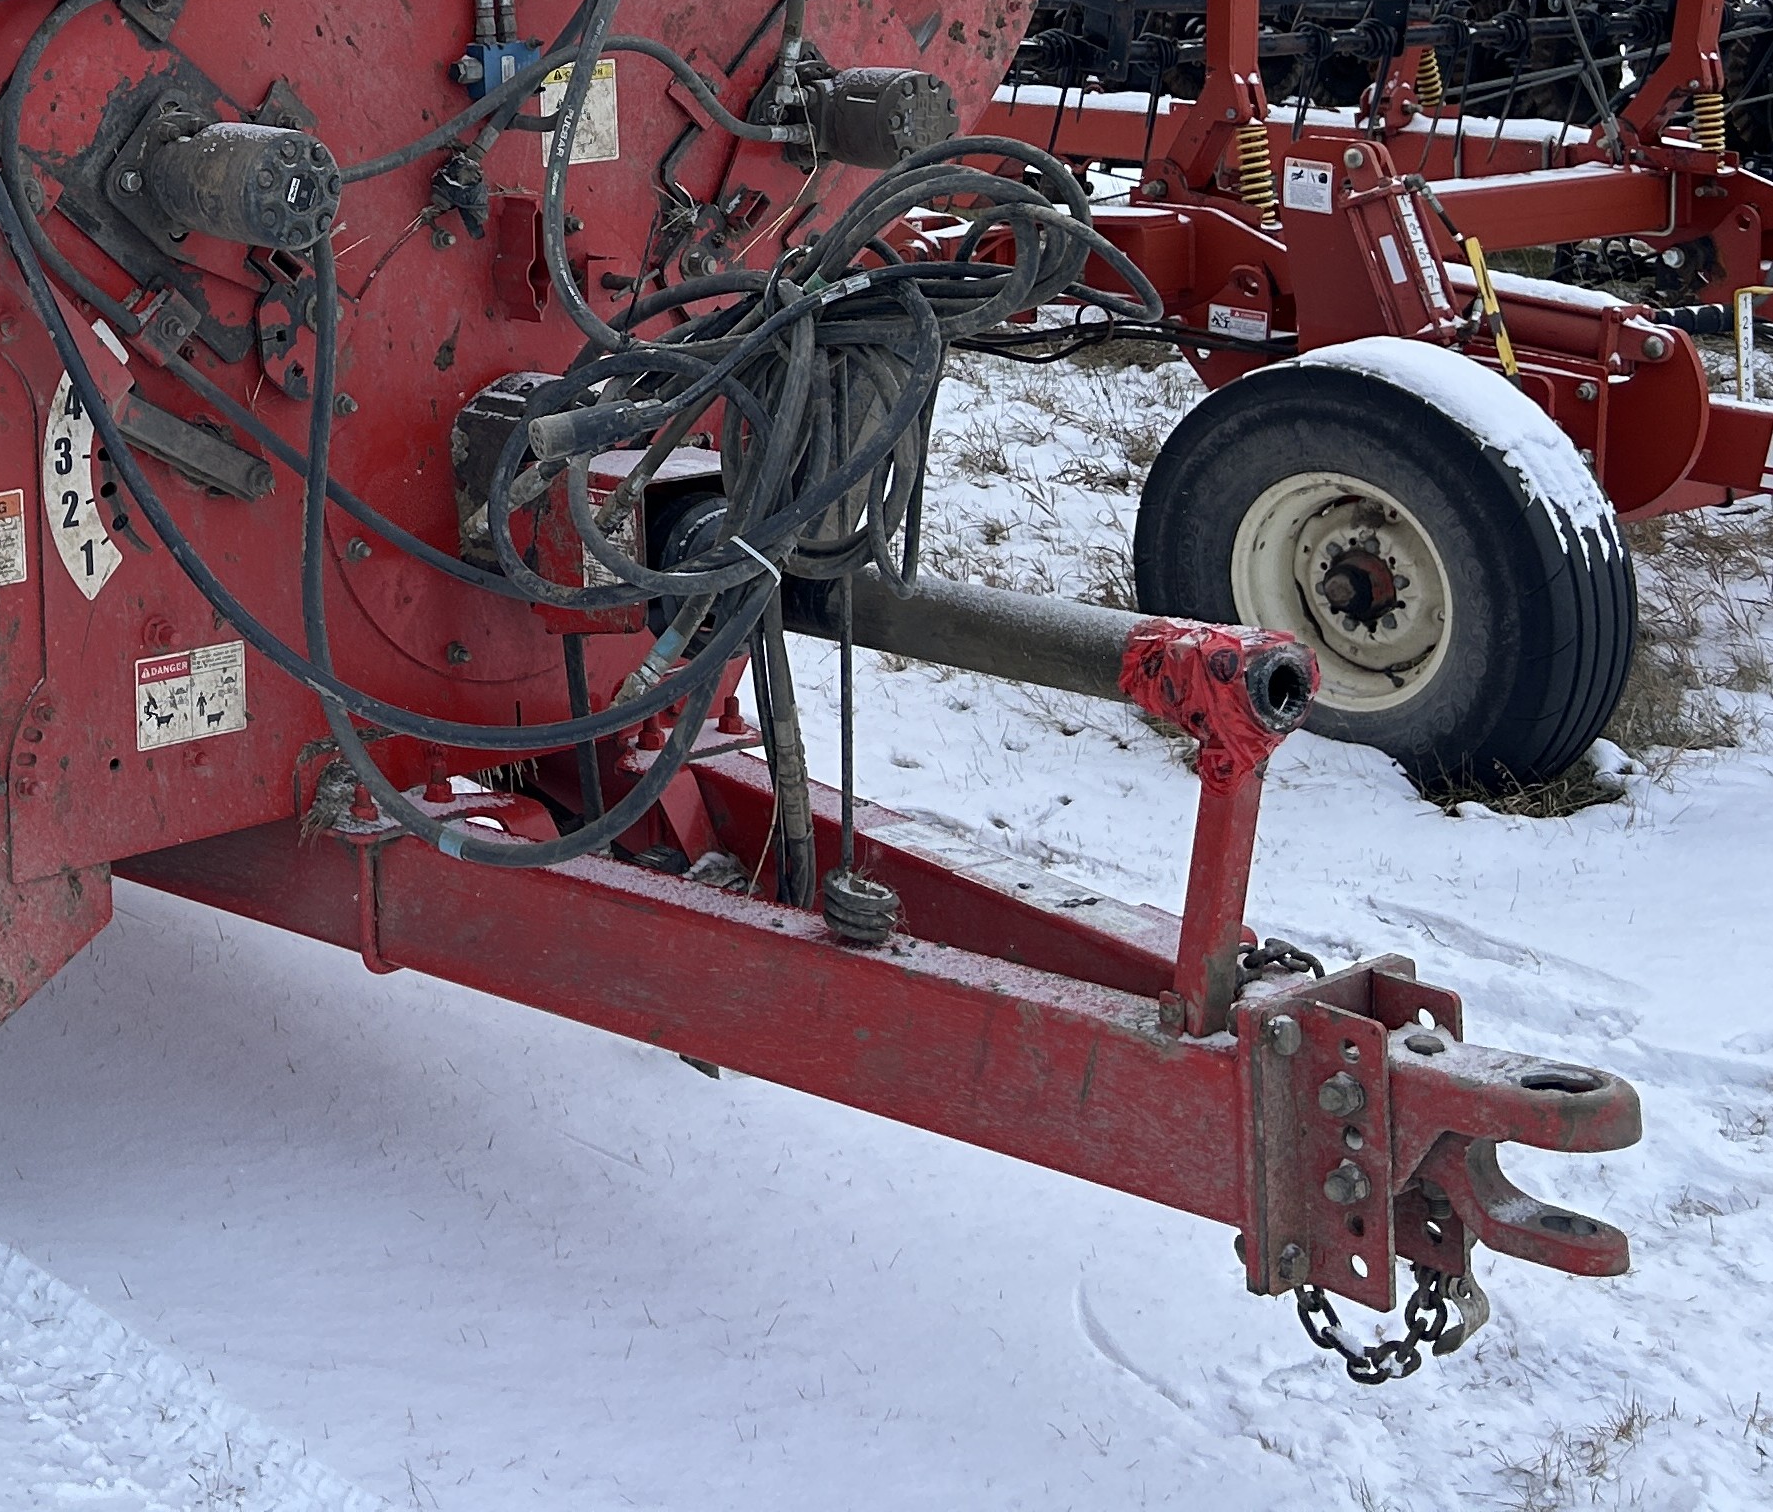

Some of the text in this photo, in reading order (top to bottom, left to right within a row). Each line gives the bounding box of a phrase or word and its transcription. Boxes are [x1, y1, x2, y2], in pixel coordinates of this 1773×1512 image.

[1409, 222, 1417, 236] 3
[1418, 248, 1426, 261] 5
[1742, 315, 1749, 330] 2
[1743, 337, 1749, 351] 3
[1743, 357, 1750, 370] 4
[1744, 378, 1750, 392] 5
[64, 384, 83, 421] 4
[54, 437, 73, 476] 3
[62, 490, 80, 529] 2
[80, 539, 95, 577] 1
[150, 661, 188, 676] DANGER
